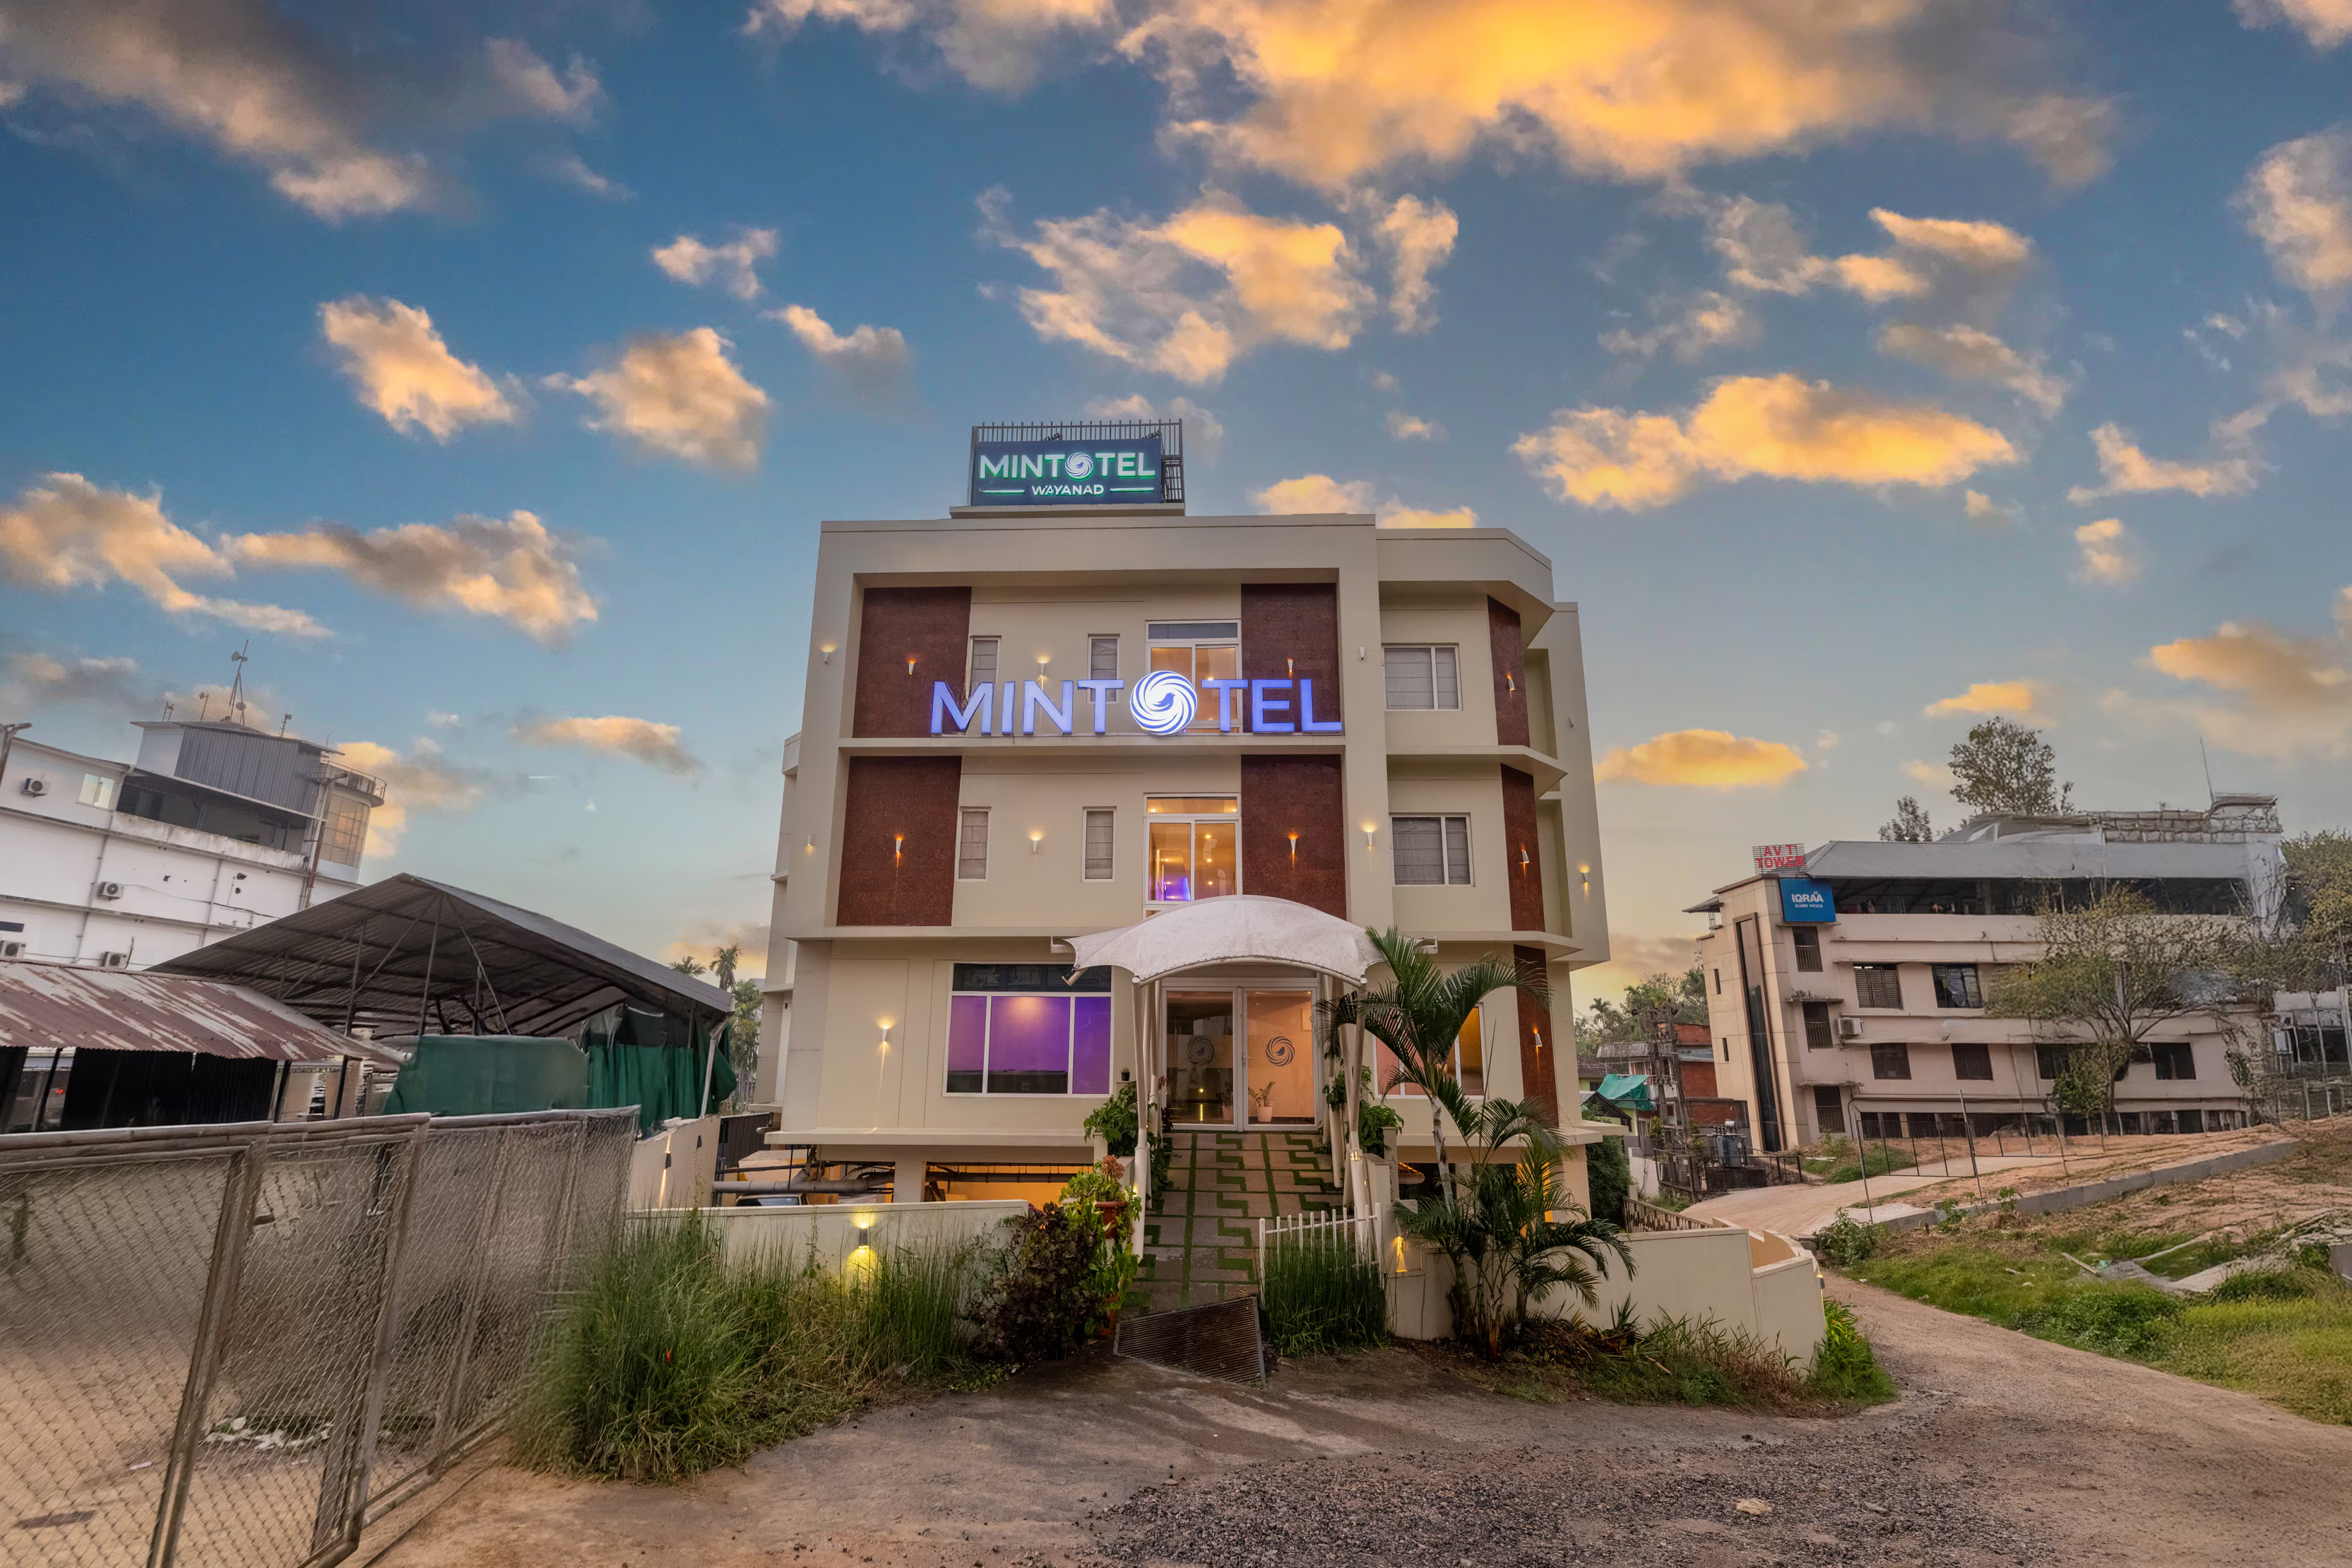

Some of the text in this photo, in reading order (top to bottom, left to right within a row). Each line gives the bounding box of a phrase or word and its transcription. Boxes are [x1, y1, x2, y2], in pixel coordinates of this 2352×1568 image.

[979, 452, 1156, 480] MINTOTEL
[1031, 485, 1104, 496] WAYANAD
[931, 670, 1342, 736] MINTOTEL
[1755, 855, 1804, 868] TOWER
